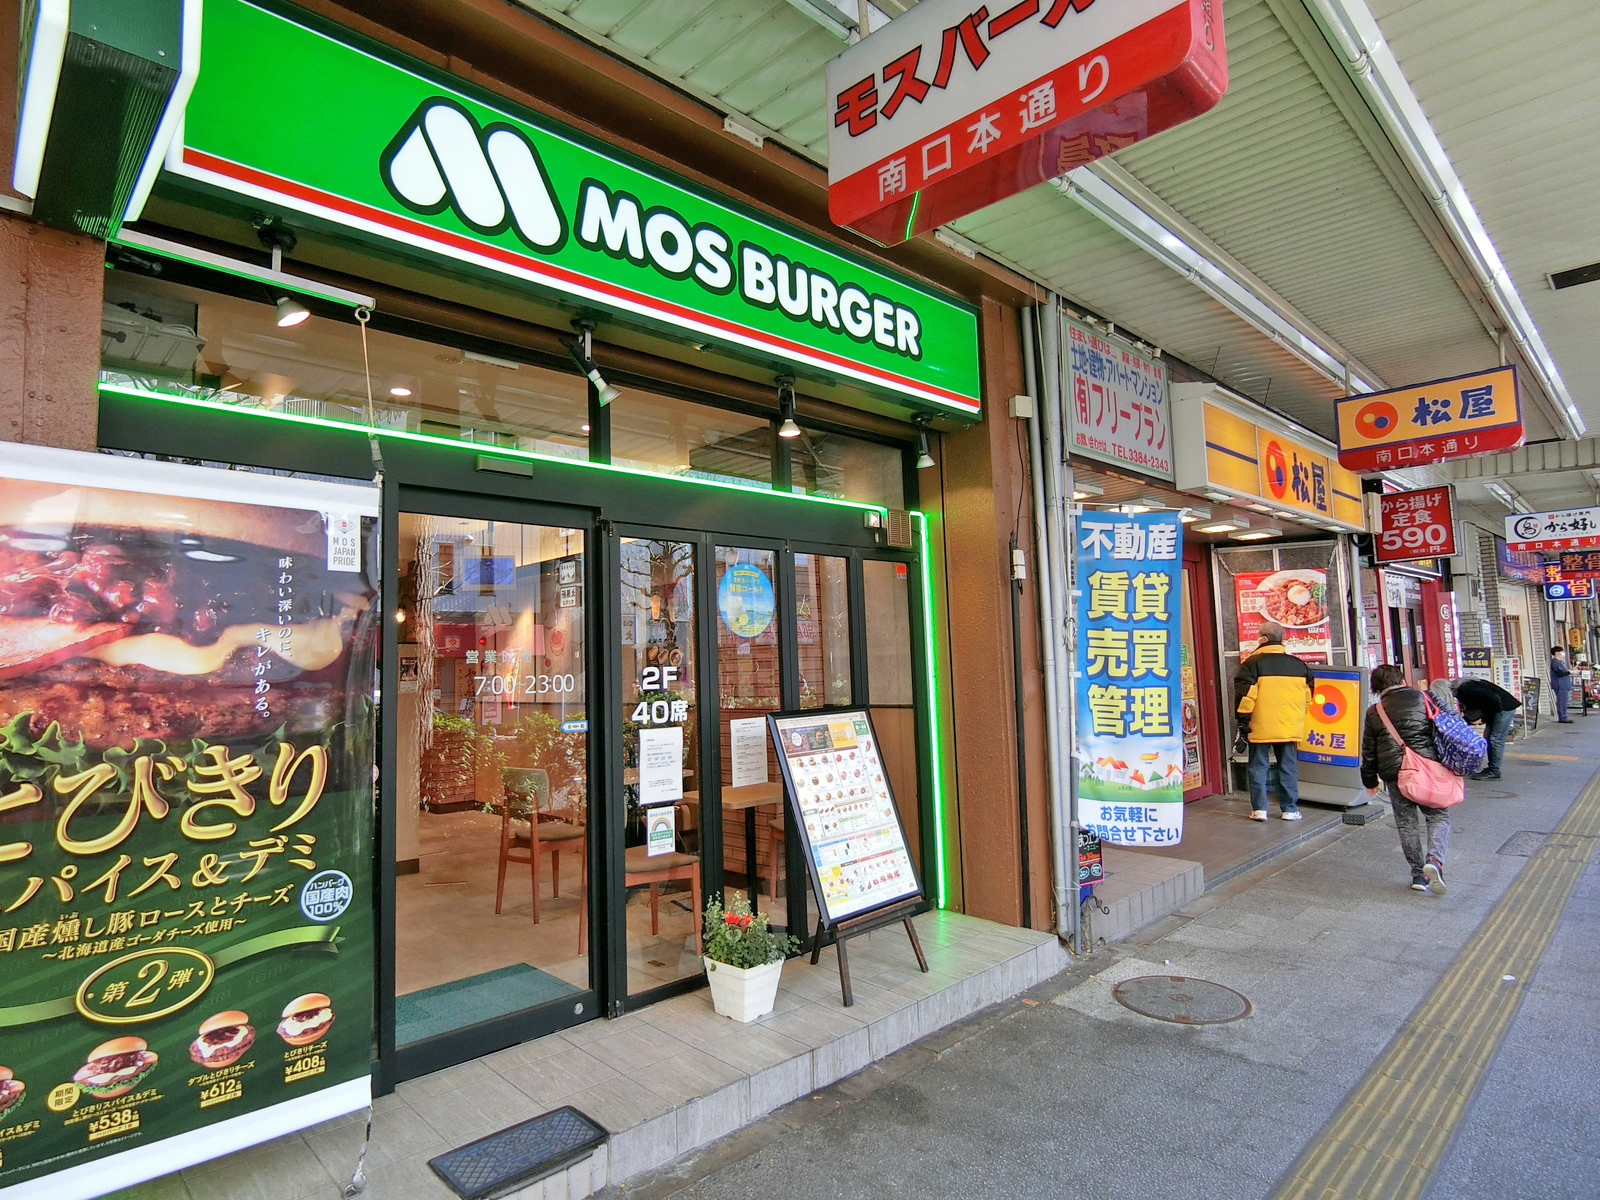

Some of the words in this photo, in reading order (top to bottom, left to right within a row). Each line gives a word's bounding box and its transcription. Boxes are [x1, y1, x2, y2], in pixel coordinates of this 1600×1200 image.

[877, 55, 1110, 203] 南口本通り
[580, 185, 732, 289] MOS
[743, 247, 921, 358] BURGER
[1411, 385, 1495, 427] 松屋
[1376, 435, 1478, 464] 南口本通り
[1291, 452, 1327, 512] 松屋
[1381, 492, 1442, 513] から揚げ
[1391, 509, 1433, 528] 定食
[333, 537, 356, 547] MOS
[1081, 522, 1177, 560] 不動産
[1382, 524, 1447, 550] 590
[1517, 538, 1597, 551] 南口本通り
[333, 547, 356, 556] JAPAN
[333, 556, 355, 566] PRIDE
[1087, 569, 1170, 620] 賃貸
[278, 556, 293, 658] 味わい深いのに、
[1087, 628, 1170, 678] 売買
[1283, 635, 1326, 648] 牛めし
[1444, 623, 1456, 680] お惣菜・お弁
[466, 649, 532, 665] 営業時間
[254, 627, 272, 718] キレがある。
[642, 666, 677, 690] 2F
[632, 699, 688, 724] 40席
[1087, 684, 1171, 736] 管理
[1307, 730, 1346, 750] 松屋
[1100, 805, 1158, 822] お気軽に
[1085, 823, 1179, 842] お問合せ下さい
[0, 834, 317, 912] パイス&デミ
[309, 878, 345, 891] ハンバーグ
[305, 886, 349, 906] 国産肉
[309, 900, 345, 916] 100%
[102, 959, 193, 1008] 第2弾
[283, 1041, 328, 1058] とびきりチーズ
[187, 1060, 256, 1086] ダブルとびきりチーズ
[54, 1096, 74, 1107] 限定
[55, 1087, 74, 1097] 期間
[72, 1089, 158, 1118] とびきりスパイス&デミ
